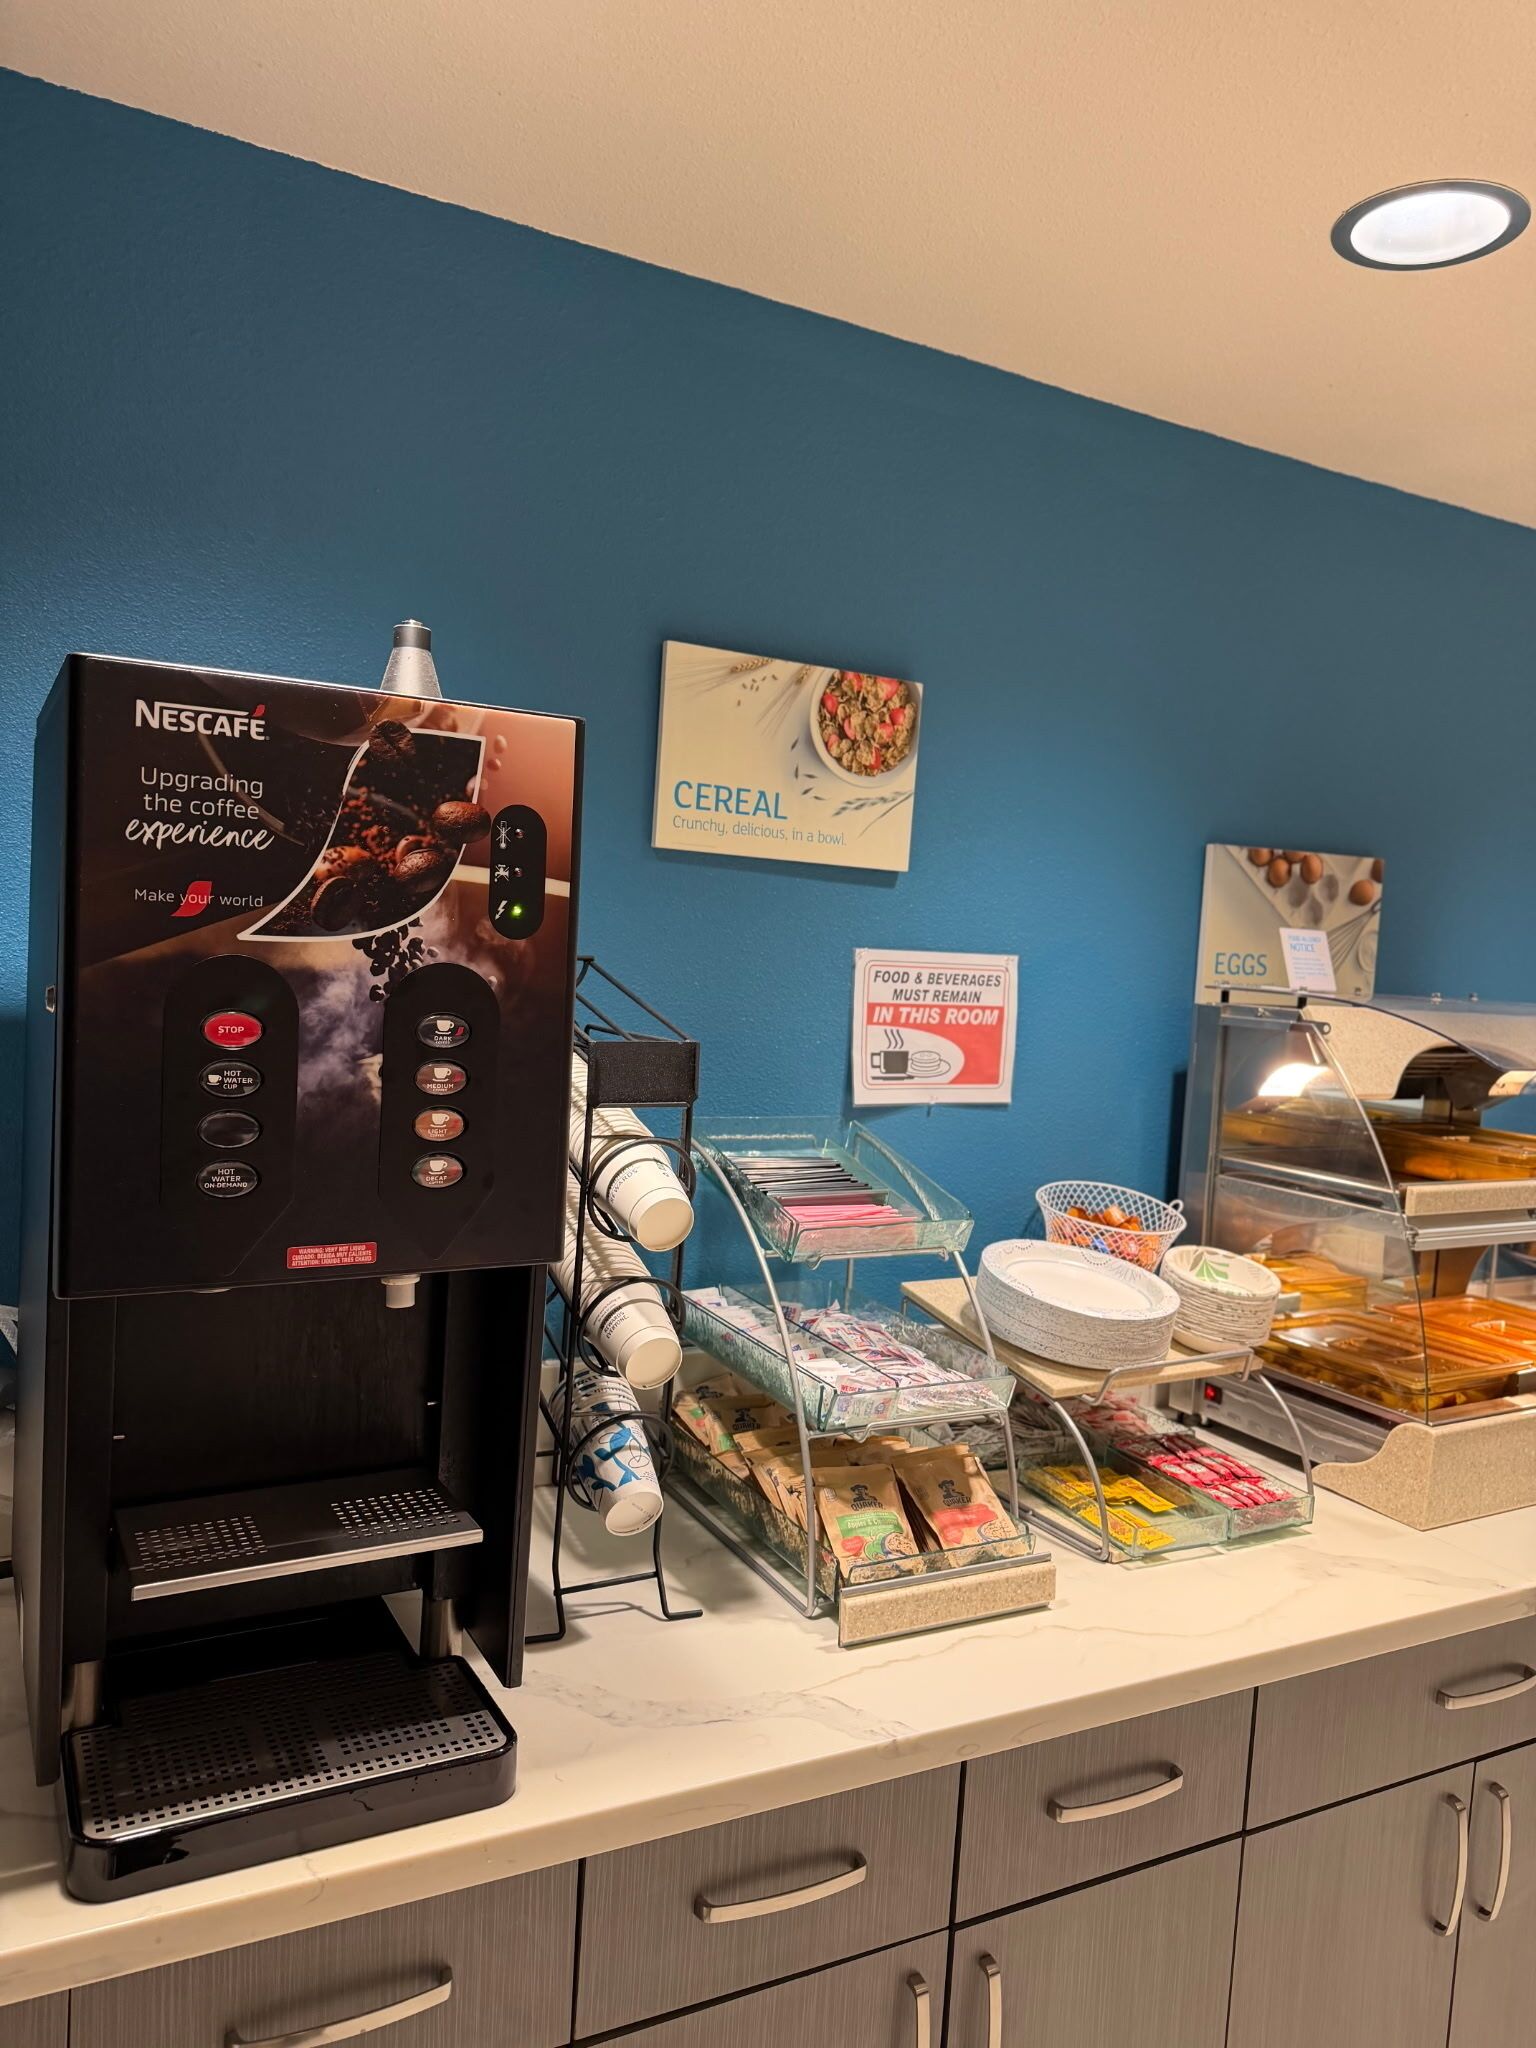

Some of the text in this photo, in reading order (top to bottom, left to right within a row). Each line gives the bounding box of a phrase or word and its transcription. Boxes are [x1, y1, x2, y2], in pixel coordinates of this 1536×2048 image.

[135, 699, 267, 740] NESCAFÉ
[141, 766, 263, 799] Upgrading
[143, 793, 260, 820] the coffee
[673, 780, 788, 820] CEREAL
[125, 818, 275, 850] experience
[672, 815, 847, 846] Crunchy, delicious, in a bowl.
[134, 888, 263, 907] Make your world
[1214, 952, 1268, 976] EGGS
[873, 970, 1002, 987] FOOD & BEVERAGES
[892, 988, 982, 1003] MUST REMAIN
[873, 1006, 999, 1025] IN THIS ROOM
[218, 1025, 244, 1034] STOP
[604, 1310, 625, 1333] REWARDS
[850, 1500, 885, 1511] QUAKER
